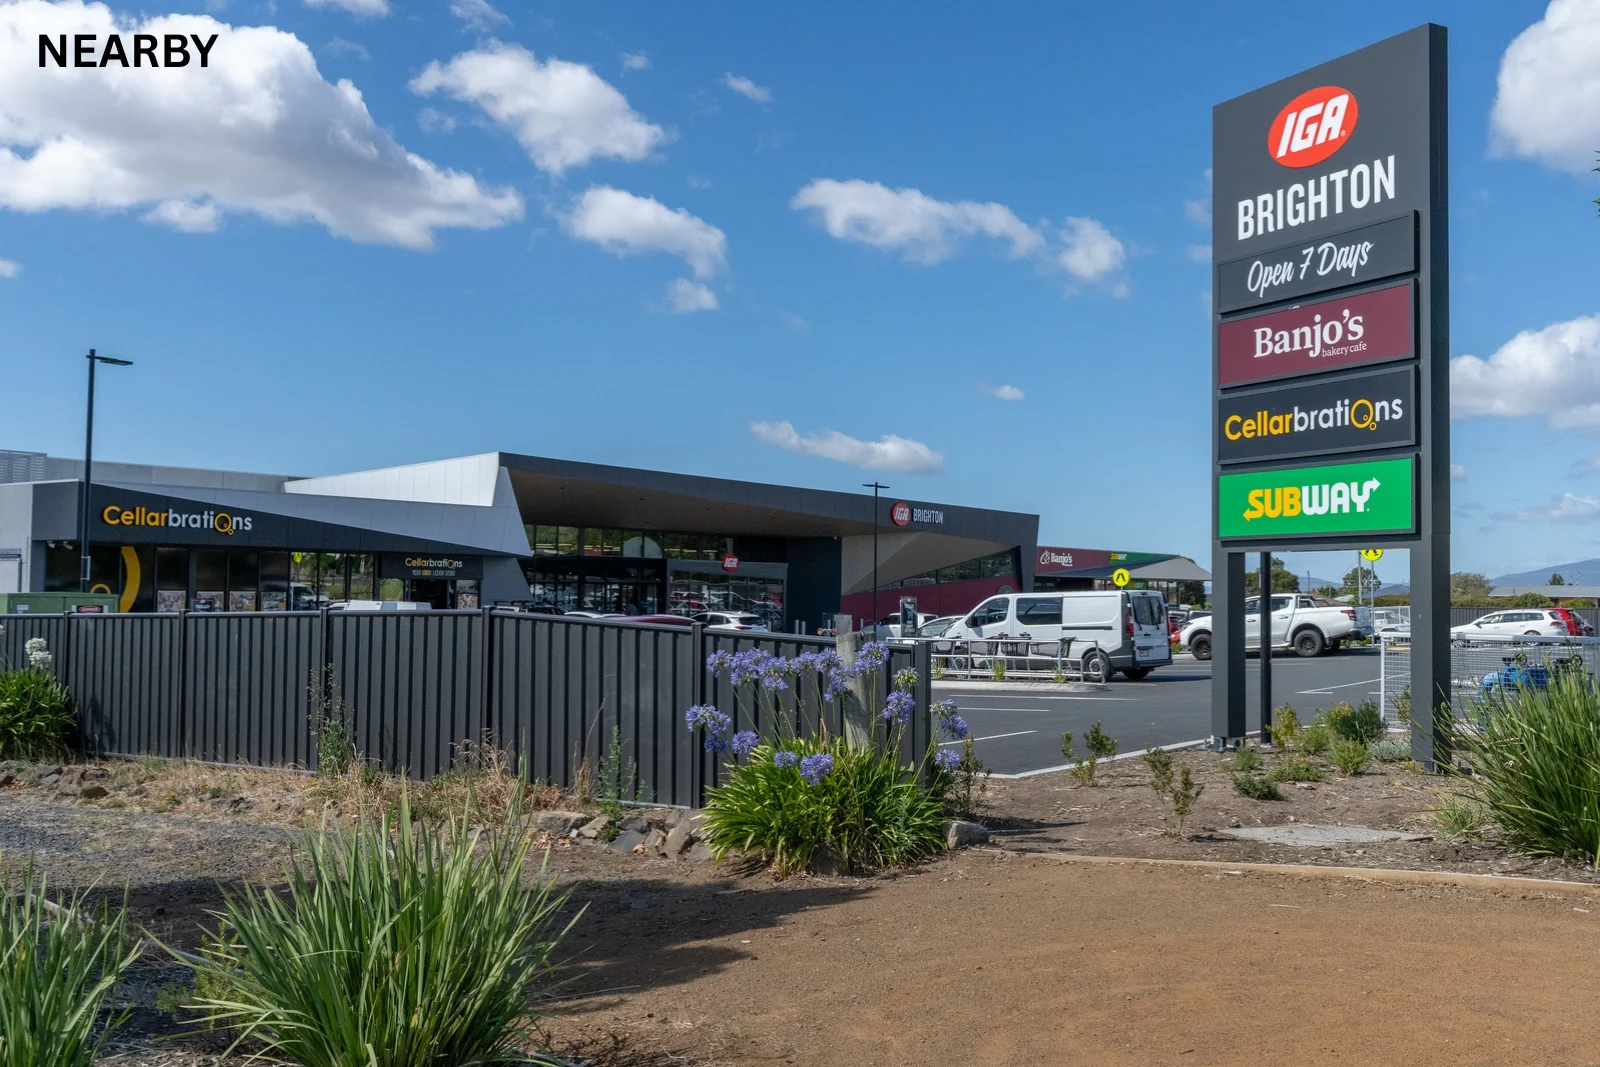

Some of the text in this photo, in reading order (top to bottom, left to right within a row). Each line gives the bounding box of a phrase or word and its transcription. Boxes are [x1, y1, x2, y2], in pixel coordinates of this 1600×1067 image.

[1276, 93, 1349, 158] IGA
[1237, 154, 1396, 241] BRIGHTON
[1246, 241, 1375, 298] Open 7 Days
[1253, 308, 1365, 359] Banjo's
[1321, 340, 1368, 358] bakery cafe
[894, 507, 944, 524] IGA BRIGHTON
[1242, 476, 1381, 522] SUBWAY
[724, 558, 738, 567] IGA
[1050, 552, 1073, 566] Banjo's
